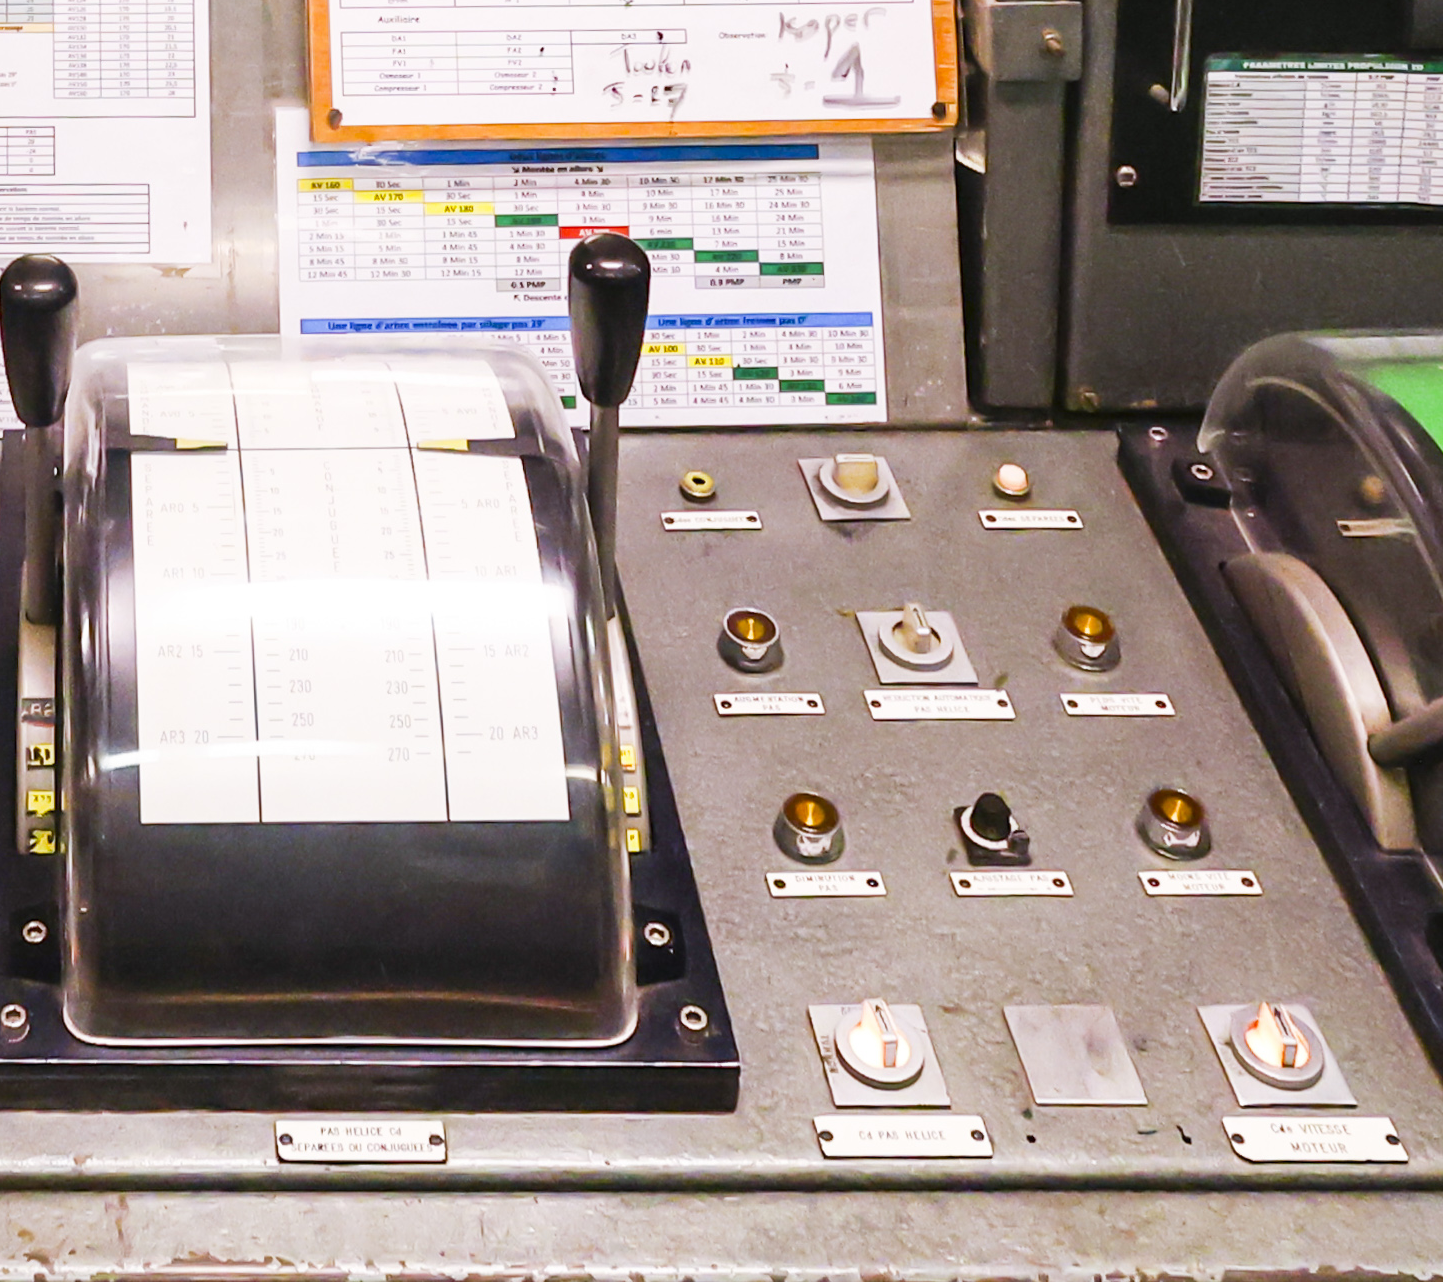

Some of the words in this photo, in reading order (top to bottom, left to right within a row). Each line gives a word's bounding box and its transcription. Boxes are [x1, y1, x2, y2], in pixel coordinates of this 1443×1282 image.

[376, 15, 421, 25] Auxiliaire
[159, 731, 186, 745] AR3
[194, 730, 210, 745] 20
[489, 726, 505, 741] 20
[512, 725, 539, 741] AR3
[1291, 1141, 1349, 1155] MOTEUR
